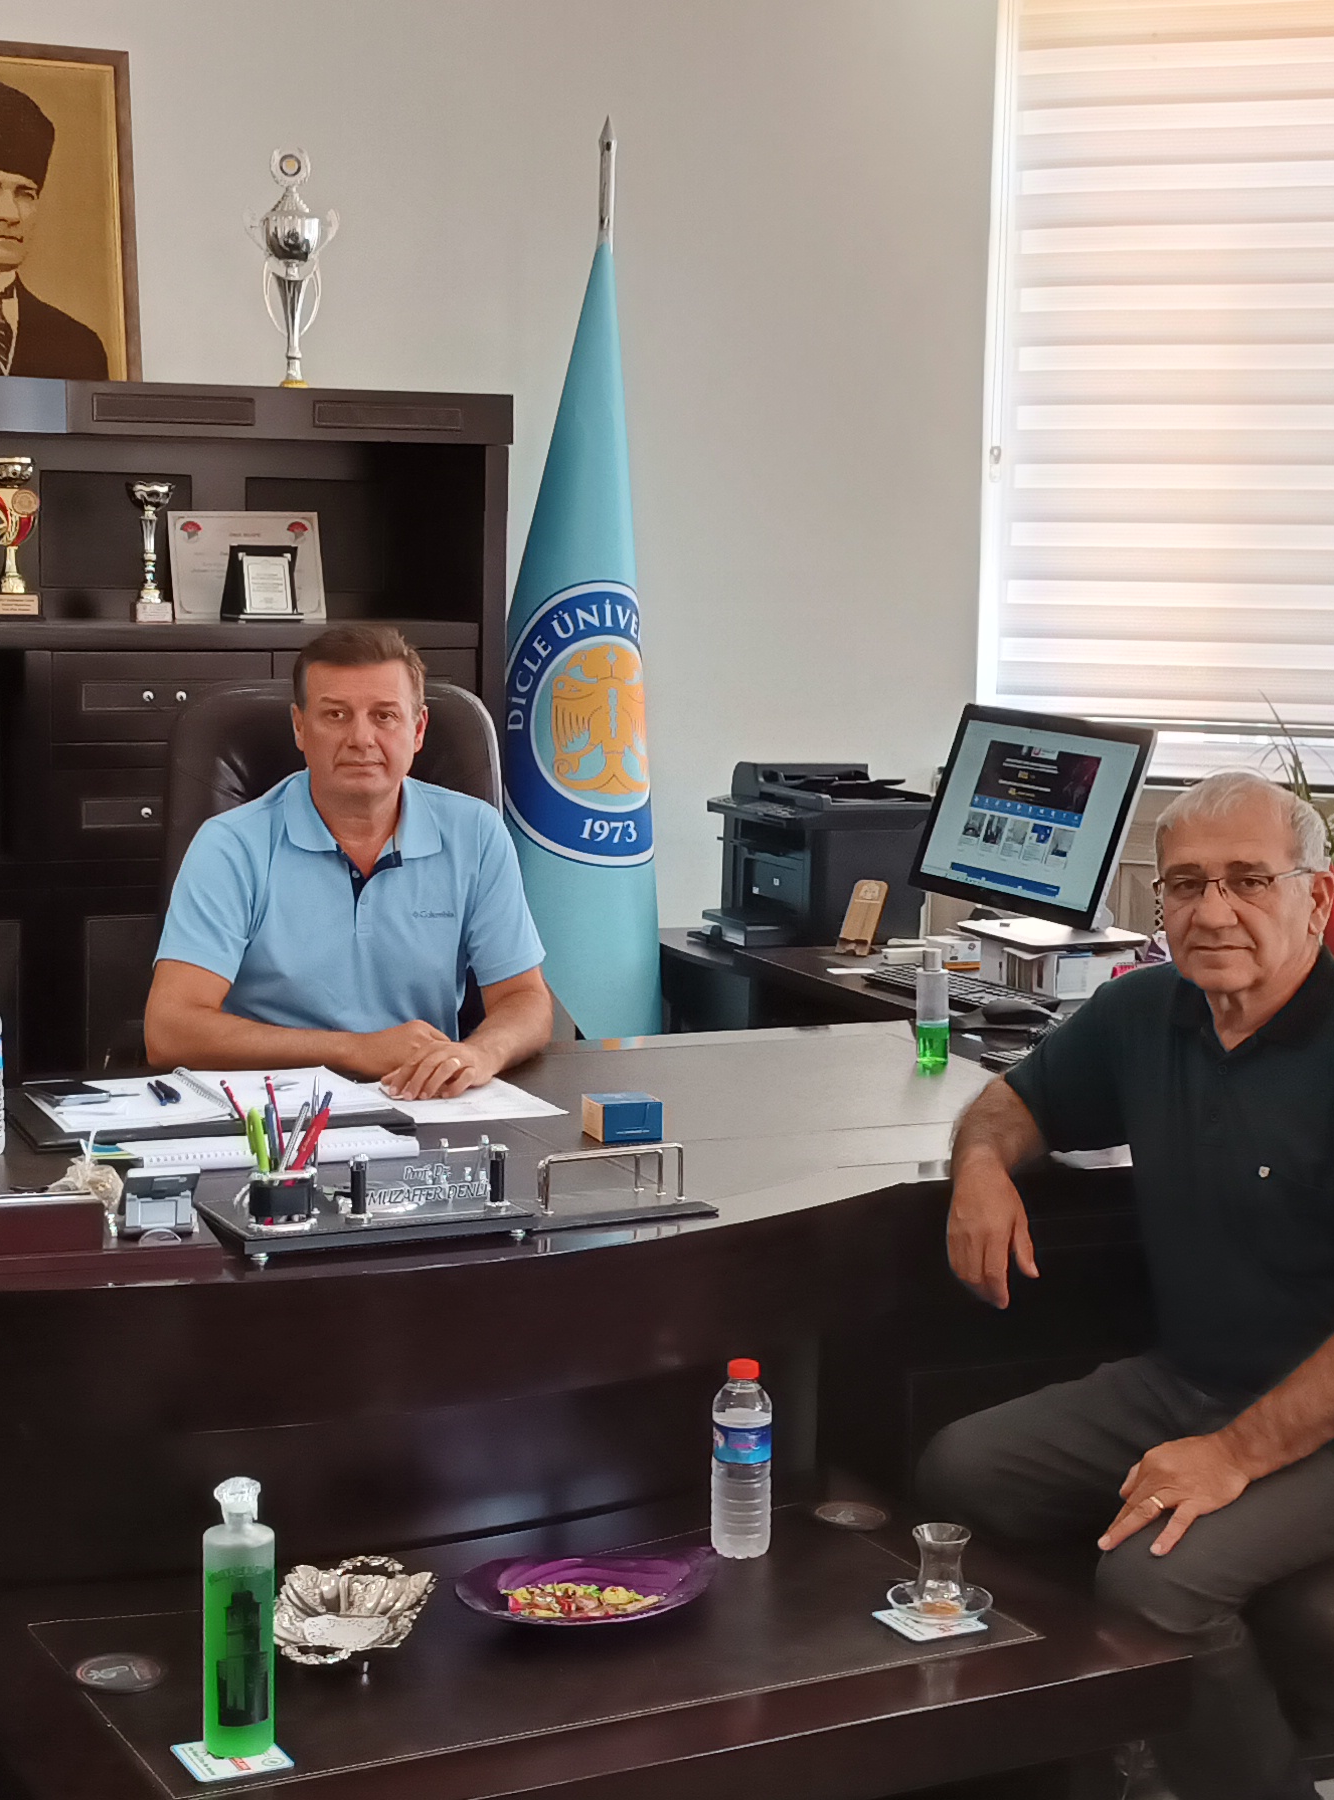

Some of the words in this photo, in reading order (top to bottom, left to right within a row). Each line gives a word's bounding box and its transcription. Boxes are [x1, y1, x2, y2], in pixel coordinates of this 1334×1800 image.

[507, 635, 553, 731] DİCLE
[550, 598, 641, 642] ÜNİVE
[579, 818, 638, 844] 1973
[367, 1186, 443, 1206] MUZAFFER
